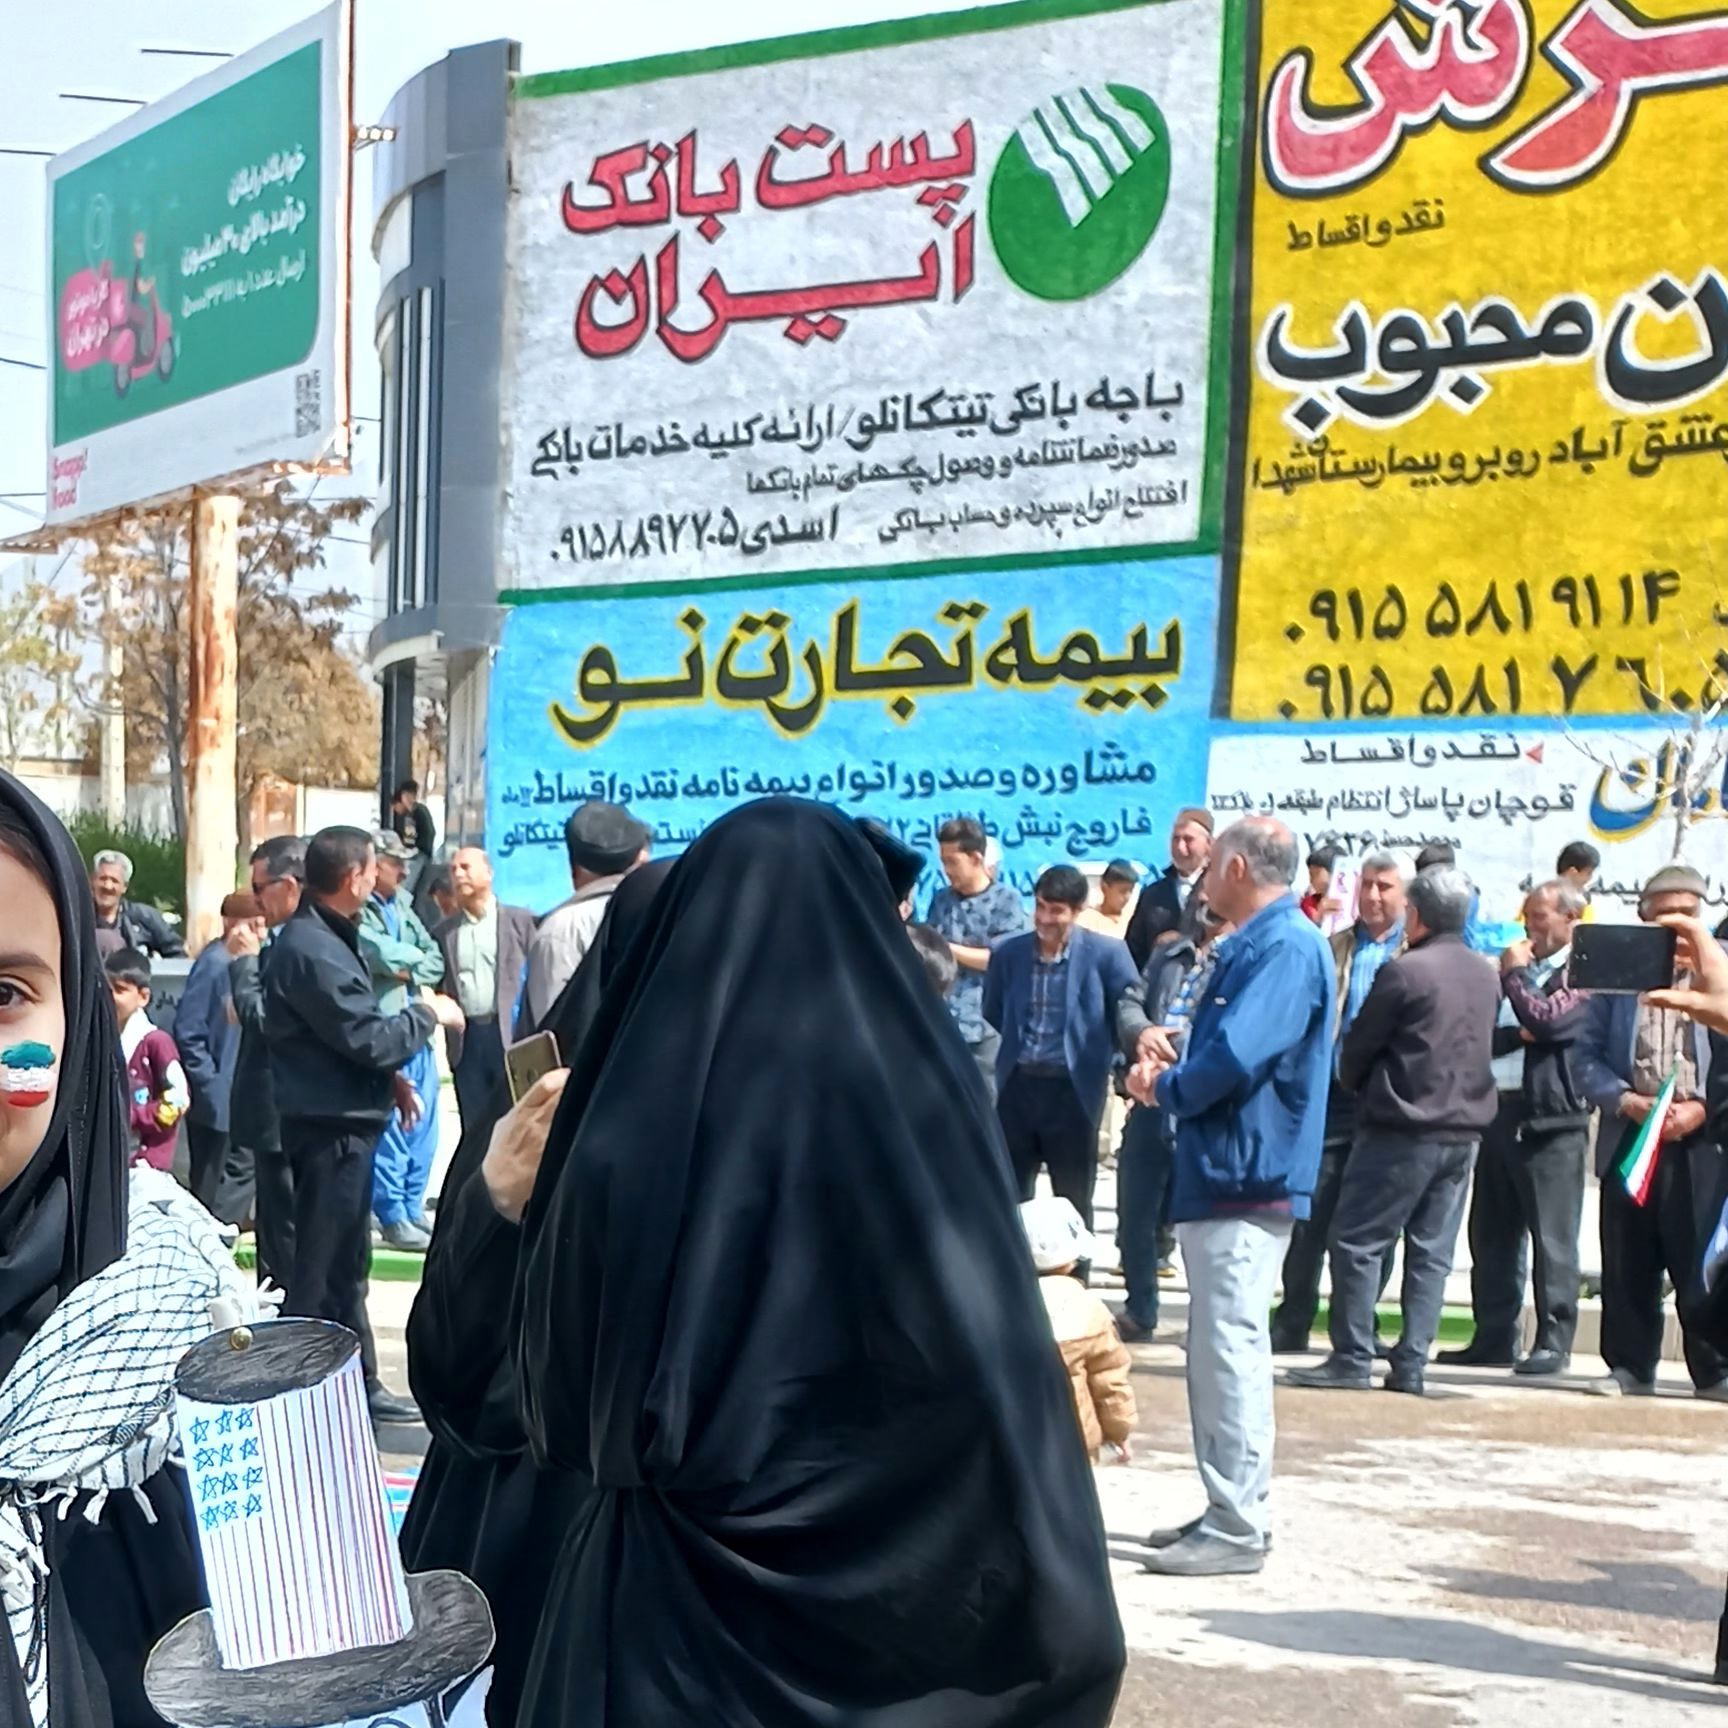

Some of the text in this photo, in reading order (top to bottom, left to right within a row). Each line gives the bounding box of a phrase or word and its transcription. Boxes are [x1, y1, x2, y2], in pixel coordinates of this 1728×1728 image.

[561, 119, 976, 244] پست بانک
[1286, 212, 1372, 252] اقساط
[1394, 197, 1445, 235] نقد
[575, 209, 976, 363] ایران
[1263, 295, 1594, 434] محبوب
[990, 379, 1078, 435] بانکی
[1086, 369, 1184, 422] باجه
[587, 421, 691, 460] خدمات
[692, 412, 763, 460] کلیه
[1549, 420, 1622, 474] آباد
[1073, 486, 1120, 527] انواع
[1124, 480, 1188, 519] افتتاح
[740, 503, 840, 556] اسدی
[878, 507, 945, 543] بانکی
[548, 597, 1183, 750] بیمه تجارت نو
[1022, 740, 1157, 795] مشاوره
[1300, 734, 1416, 765] اقساط
[1442, 733, 1521, 761] نقد
[534, 770, 618, 803] اقساط
[637, 768, 678, 799] نقد
[682, 767, 739, 798] نامه
[898, 766, 996, 800] صدور
[1326, 784, 1391, 820] انتظام
[1387, 785, 1465, 823] پاساژ
[1468, 782, 1578, 827] قوچان
[1003, 805, 1062, 848] نبش
[1066, 806, 1153, 855] فاروج
